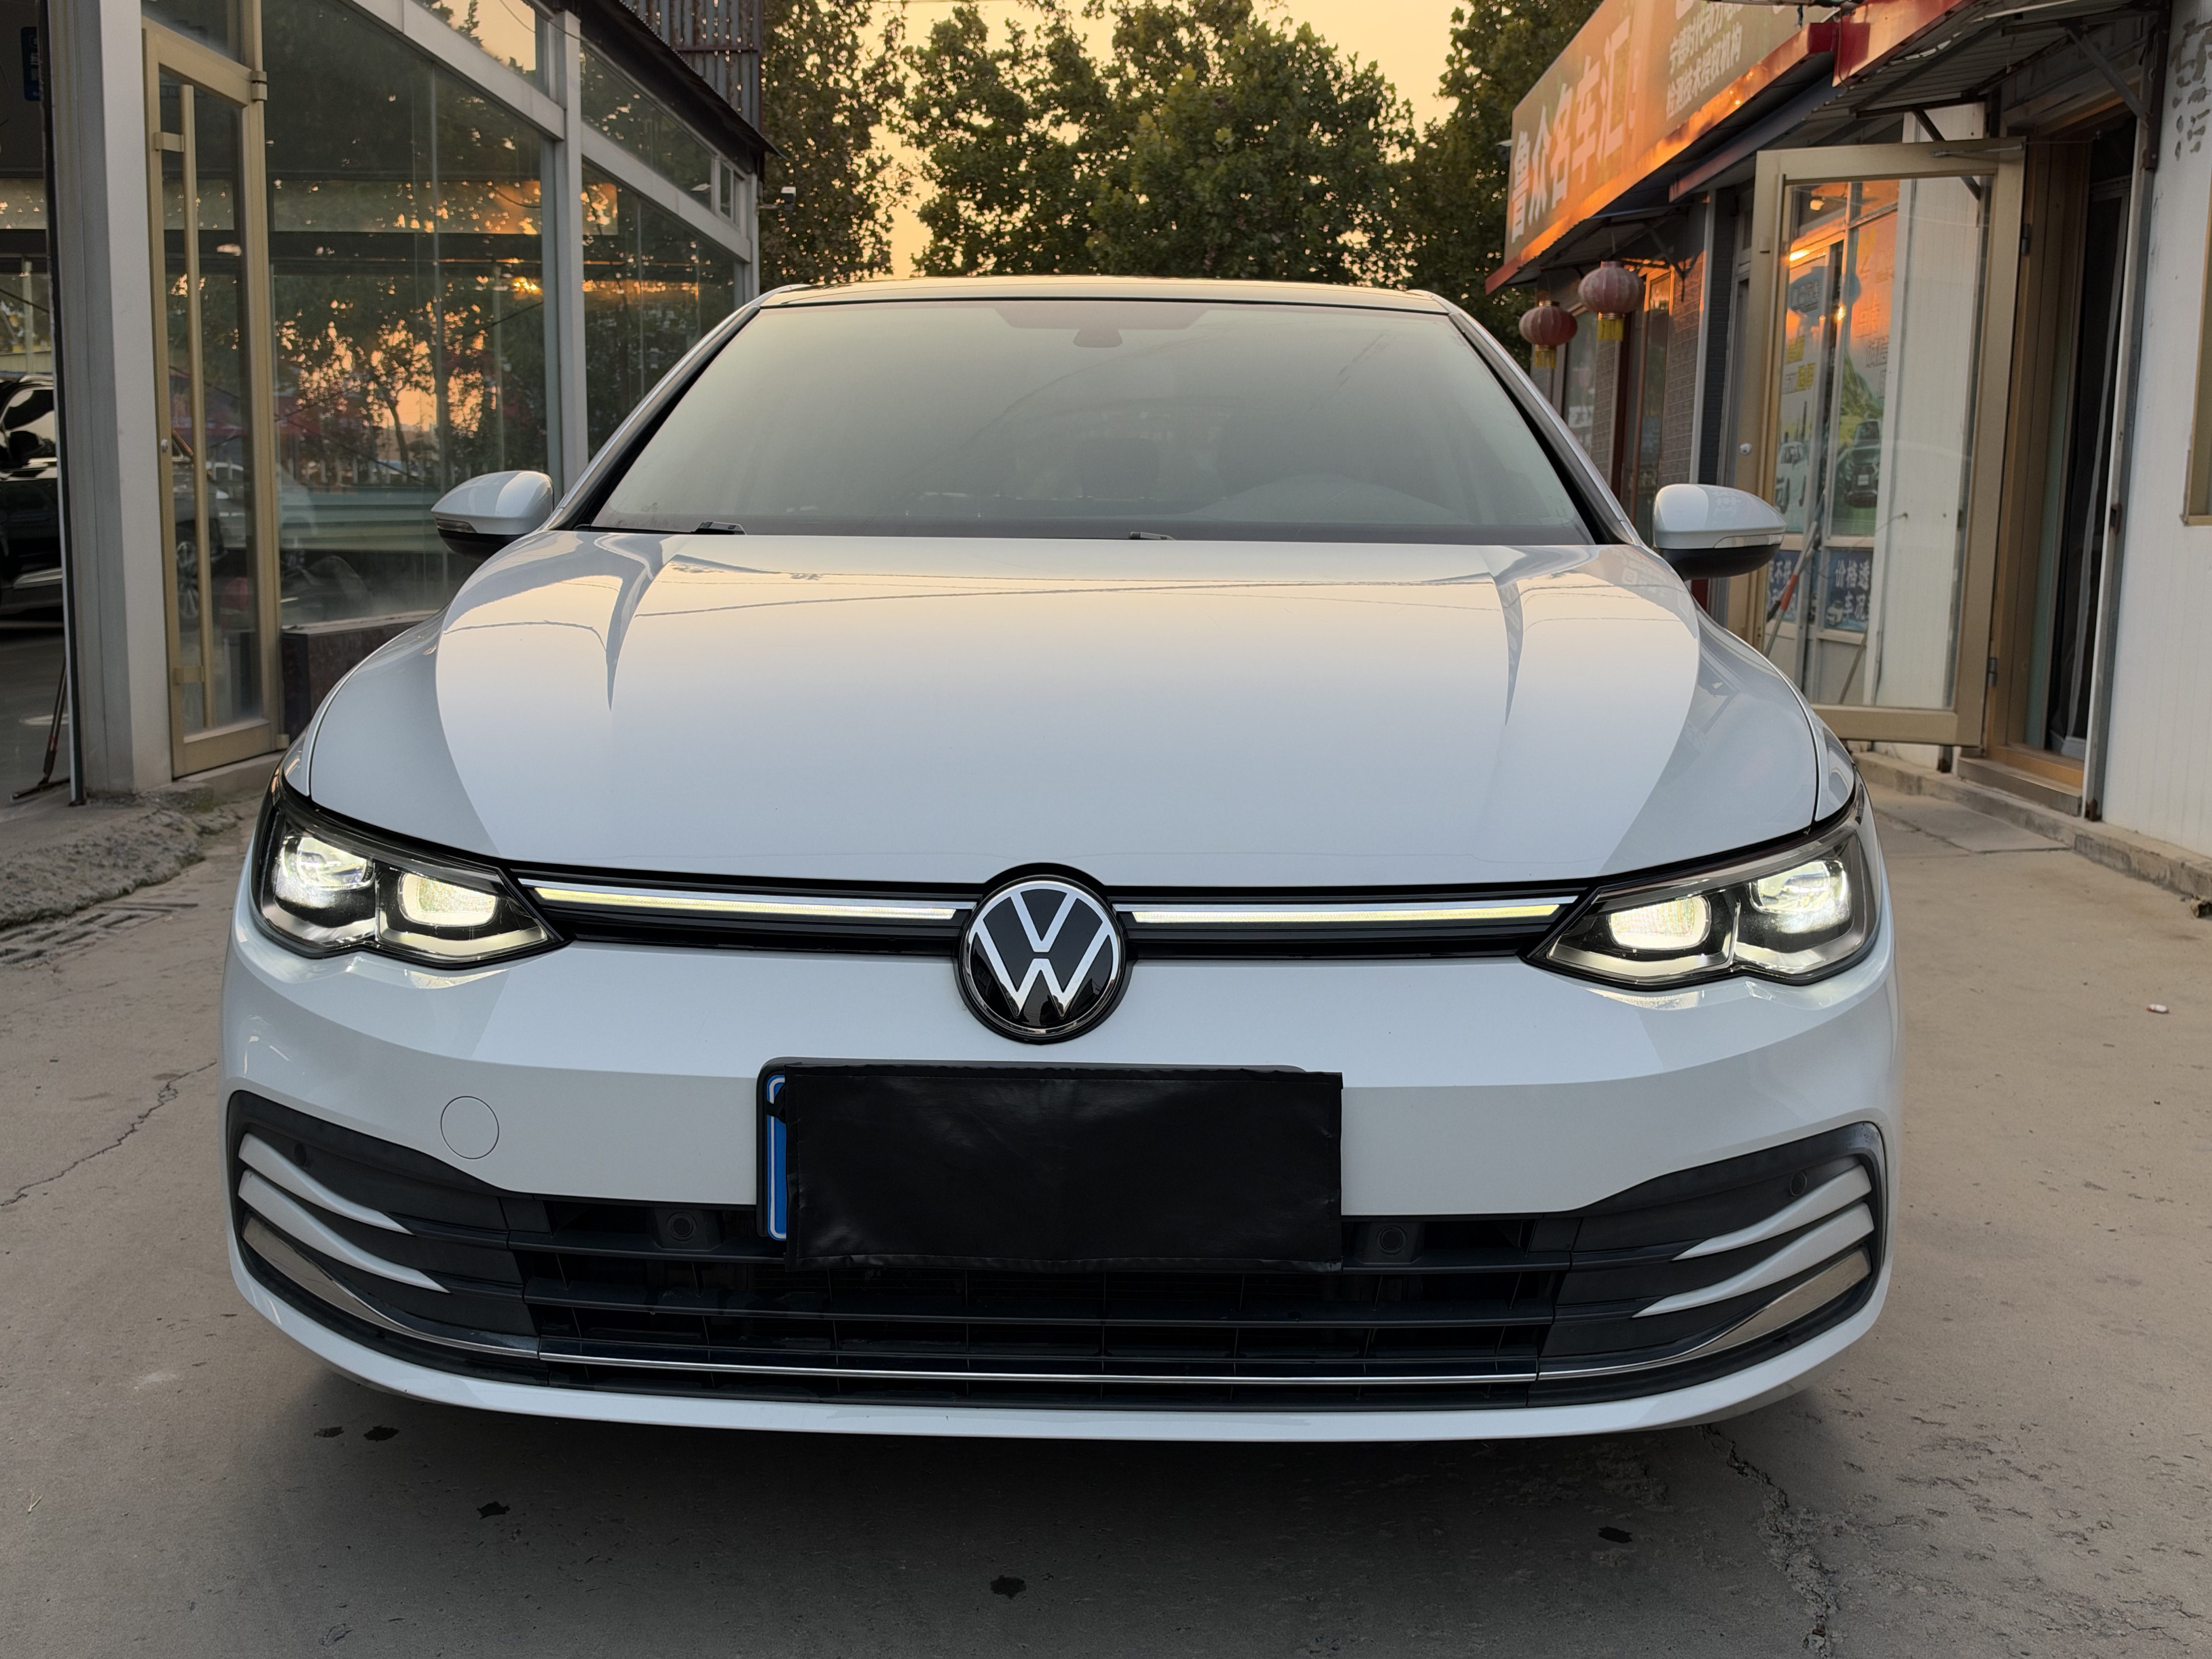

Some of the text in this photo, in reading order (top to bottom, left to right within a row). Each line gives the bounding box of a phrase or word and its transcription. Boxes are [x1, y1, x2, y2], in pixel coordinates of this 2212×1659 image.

[1511, 18, 1630, 243] 鲁众名车汇
